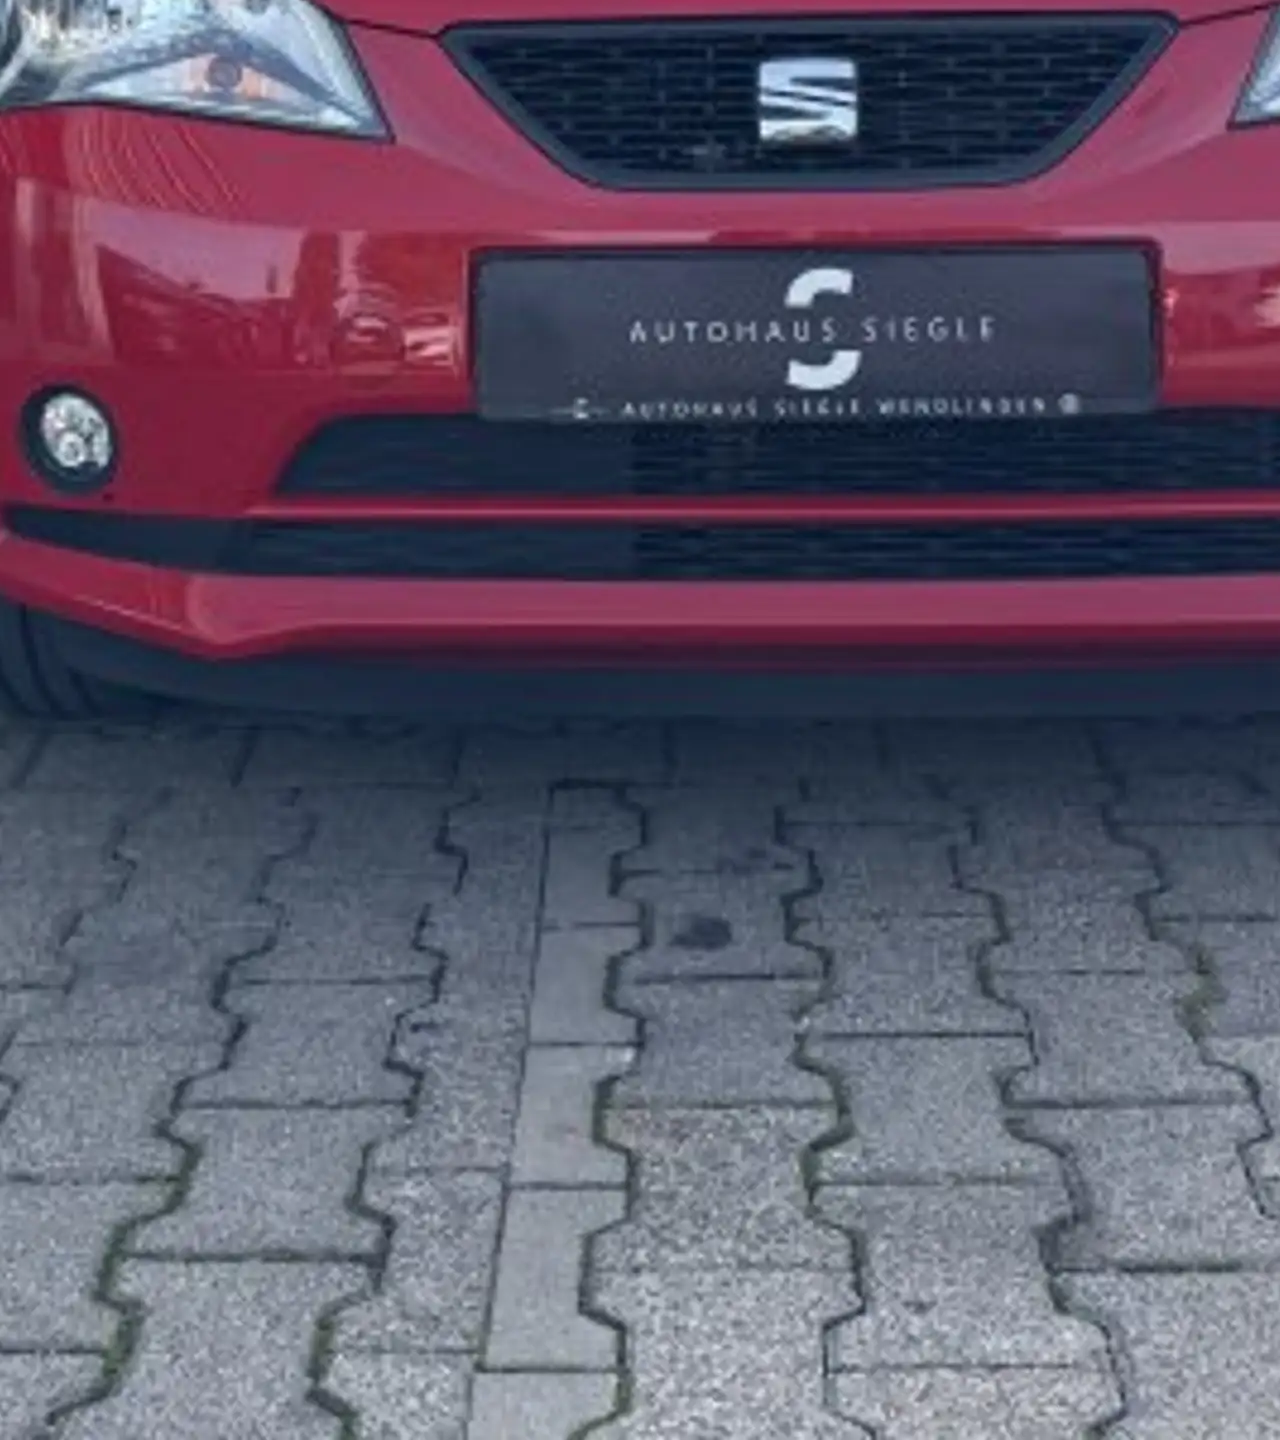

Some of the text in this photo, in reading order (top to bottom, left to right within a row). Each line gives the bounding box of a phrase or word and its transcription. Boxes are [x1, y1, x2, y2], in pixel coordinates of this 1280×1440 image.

[629, 315, 996, 344] AUTOHAUS SIEGLE
[623, 399, 758, 421] AUTOHAUS
